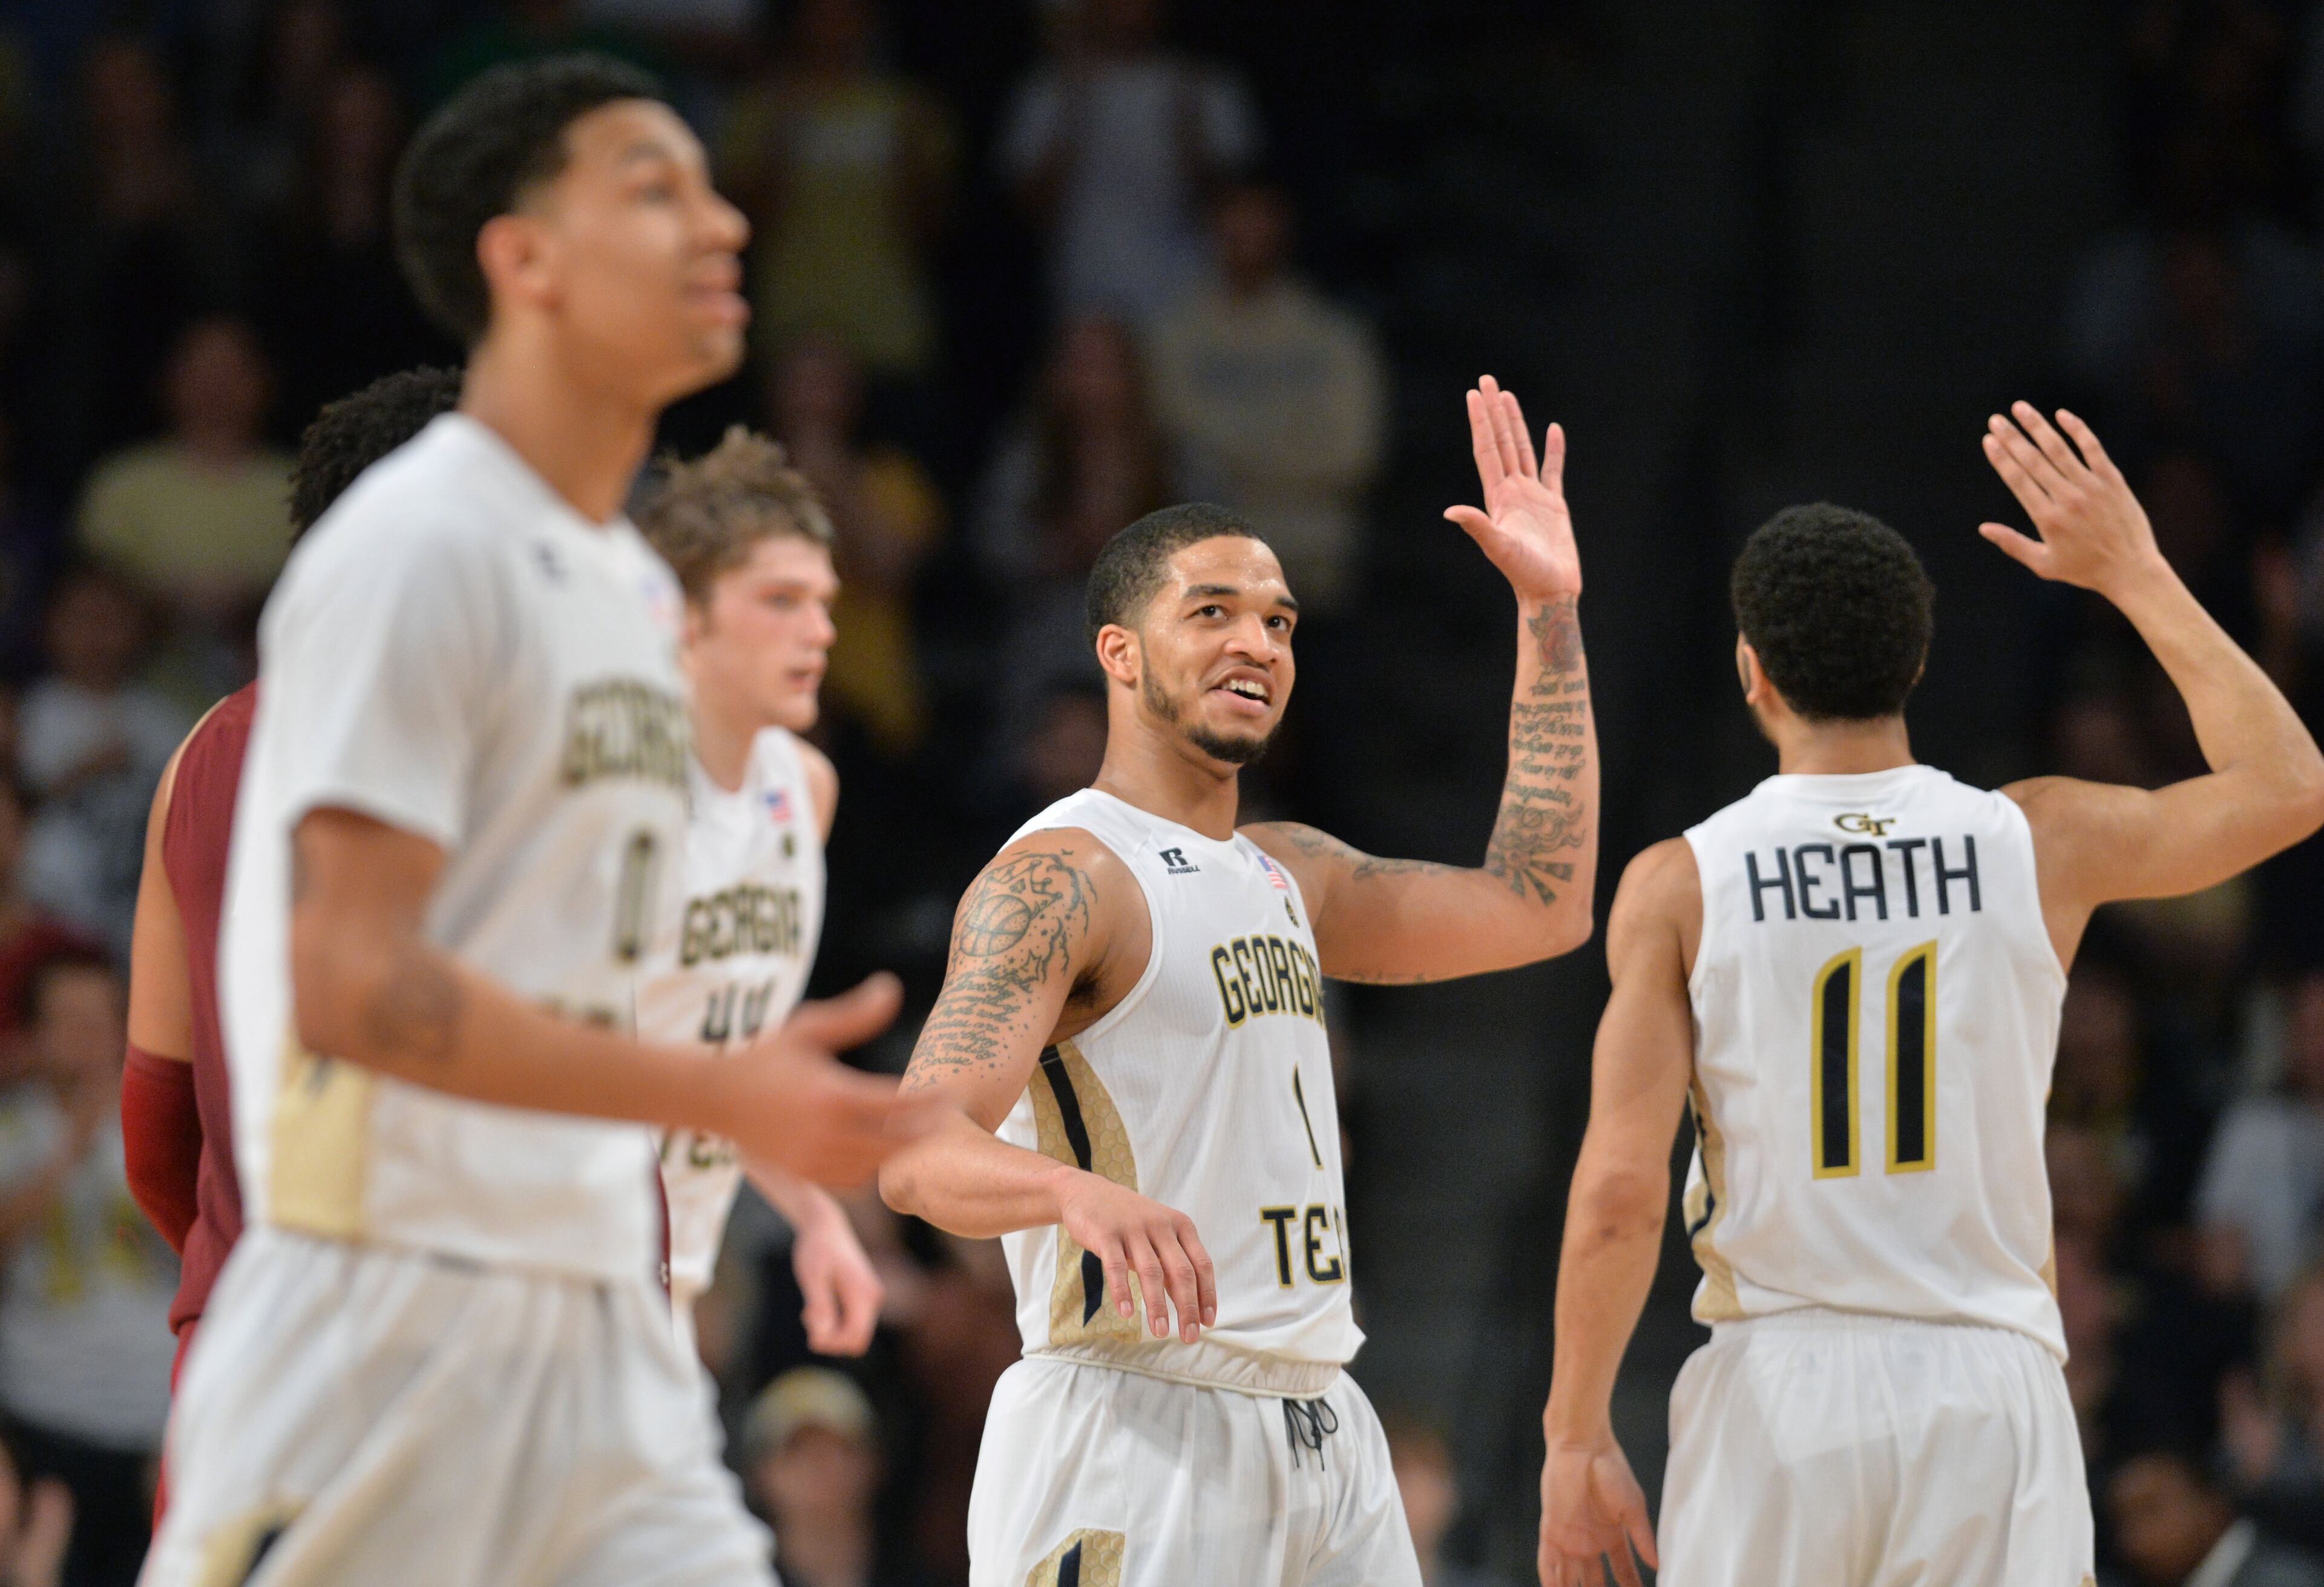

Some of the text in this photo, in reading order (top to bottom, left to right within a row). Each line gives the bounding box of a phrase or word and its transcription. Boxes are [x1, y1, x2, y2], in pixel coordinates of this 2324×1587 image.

[611, 826, 659, 968] 0
[1167, 865, 1201, 875] RUSSELL
[1745, 834, 1982, 922] HEATH
[680, 879, 803, 968] GEORGIA
[700, 979, 775, 1045] 44
[1810, 938, 1938, 1180] 11
[1292, 1062, 1325, 1170] 1
[1259, 1203, 1347, 1289] TE
